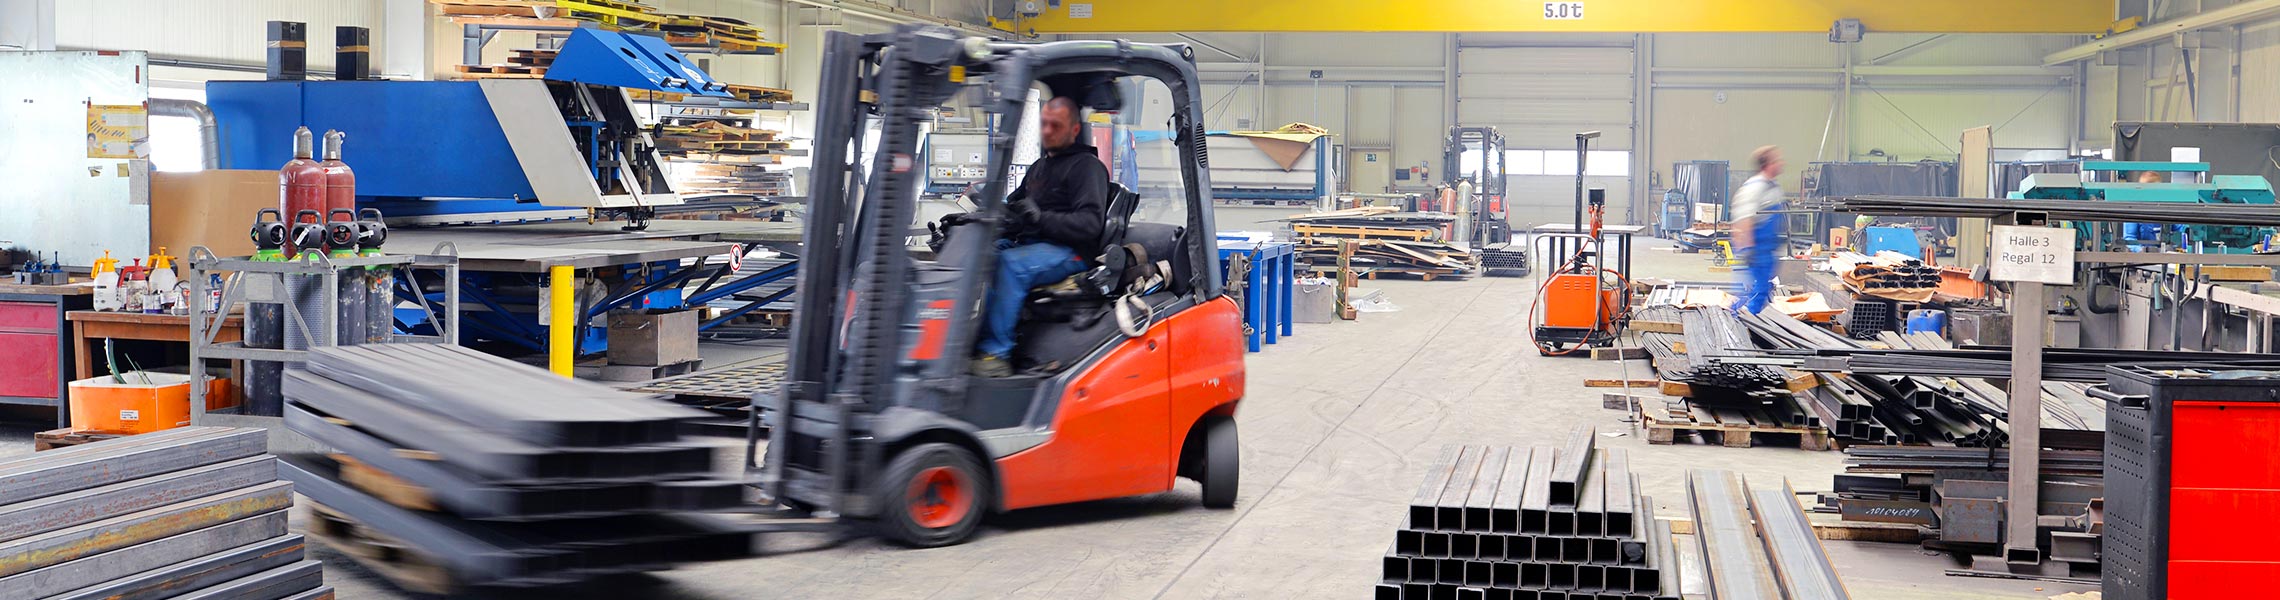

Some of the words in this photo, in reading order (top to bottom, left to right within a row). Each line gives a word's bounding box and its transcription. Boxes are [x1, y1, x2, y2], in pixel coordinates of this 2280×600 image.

[1545, 3, 1568, 18] 5.0
[1571, 3, 1582, 18] t
[2009, 236, 2039, 247] Halle
[2042, 237, 2050, 247] 3
[2002, 252, 2034, 265] Regal
[2041, 254, 2056, 264] 12
